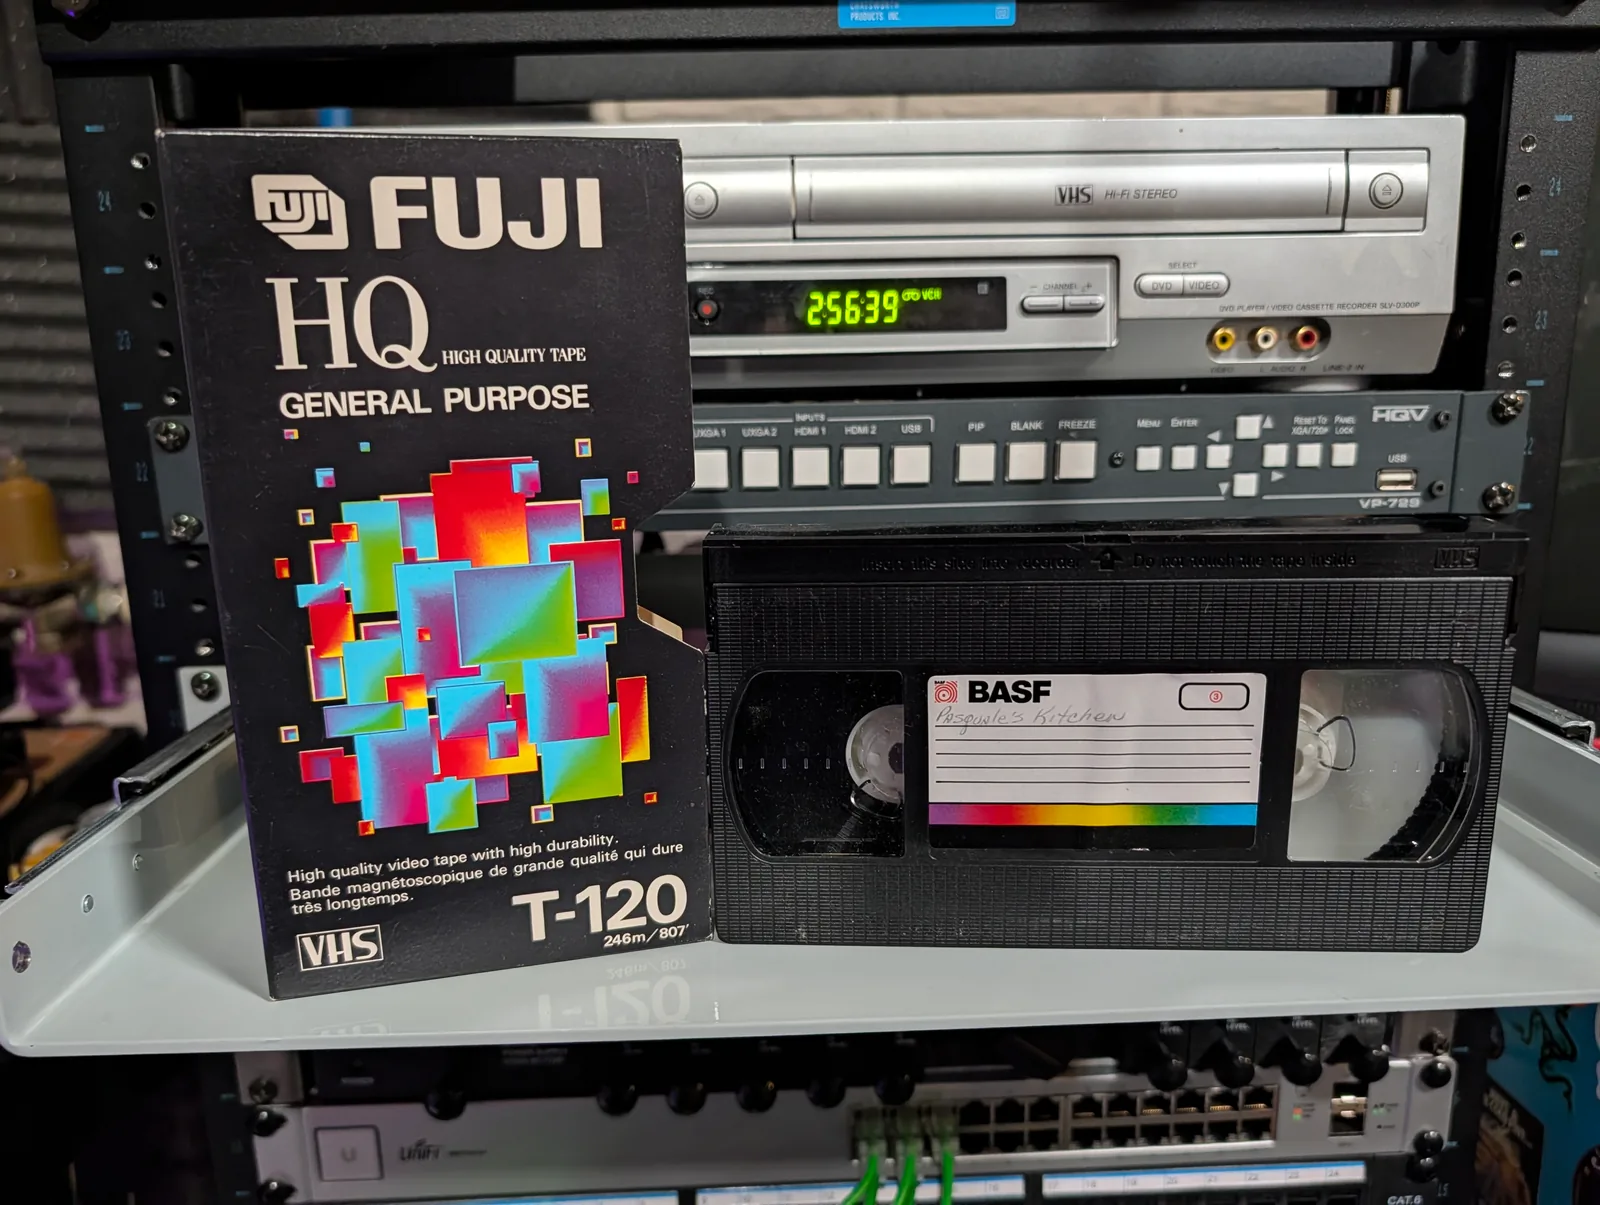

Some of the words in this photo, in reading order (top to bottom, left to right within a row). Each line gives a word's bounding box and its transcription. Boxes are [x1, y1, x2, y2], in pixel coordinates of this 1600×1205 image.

[850, 12, 884, 21] PRODUCTS
[1057, 186, 1092, 204] VHS
[1133, 188, 1178, 200] STEREO
[252, 176, 338, 236] FUJI
[370, 176, 603, 250] FUJI
[1043, 282, 1077, 290] CHANNEL
[1151, 281, 1173, 291] DVD
[1189, 281, 1220, 291] VIDEO
[1219, 304, 1234, 312] DVD
[1237, 304, 1265, 312] PLAYER
[1296, 303, 1334, 311] CASSETTE
[1337, 302, 1377, 310] RECORDER
[265, 275, 438, 373] HQ
[442, 349, 481, 365] HIGH
[485, 348, 546, 364] QUALITY
[550, 347, 587, 363] TAPE
[279, 388, 432, 419] GENERAL
[444, 384, 590, 413] PURPOSE
[795, 413, 825, 421] INPUTS
[1372, 406, 1429, 422] HQV
[845, 425, 868, 435] HDMI
[870, 425, 877, 434] 2
[901, 424, 922, 434] USB
[968, 422, 985, 431] PIP
[1011, 420, 1043, 431] BLANK
[1059, 419, 1097, 429] FREEZE
[742, 428, 770, 437] UXGA
[771, 427, 777, 436] 2
[795, 426, 819, 436] HDMI
[821, 426, 826, 435] 1
[1388, 454, 1409, 463] USB
[1358, 498, 1421, 509] VP-729
[861, 556, 903, 571] Insert
[912, 556, 936, 571] this
[1133, 553, 1153, 568] Do
[1160, 554, 1185, 568] not
[1189, 553, 1233, 568] touch
[1239, 553, 1262, 568] the
[1269, 554, 1303, 571] tape
[1311, 553, 1356, 568] inside
[968, 680, 1052, 703] BASF
[1033, 704, 1126, 725] Kitchen
[287, 868, 325, 884] High
[329, 862, 383, 880] quality
[387, 857, 430, 872] video
[434, 853, 467, 869] tape
[472, 847, 505, 862] with
[509, 842, 542, 859] high
[546, 834, 619, 852] durability.
[290, 886, 341, 901] Bande
[347, 869, 484, 894] magnétoscopique
[489, 864, 508, 878] de
[513, 858, 565, 876] grande
[570, 850, 619, 867] qualité
[624, 846, 646, 861] qui
[652, 842, 684, 856] dure
[291, 902, 322, 915] très
[327, 891, 414, 911] longtemps.
[511, 874, 688, 942] T-120
[301, 928, 378, 967] VHS
